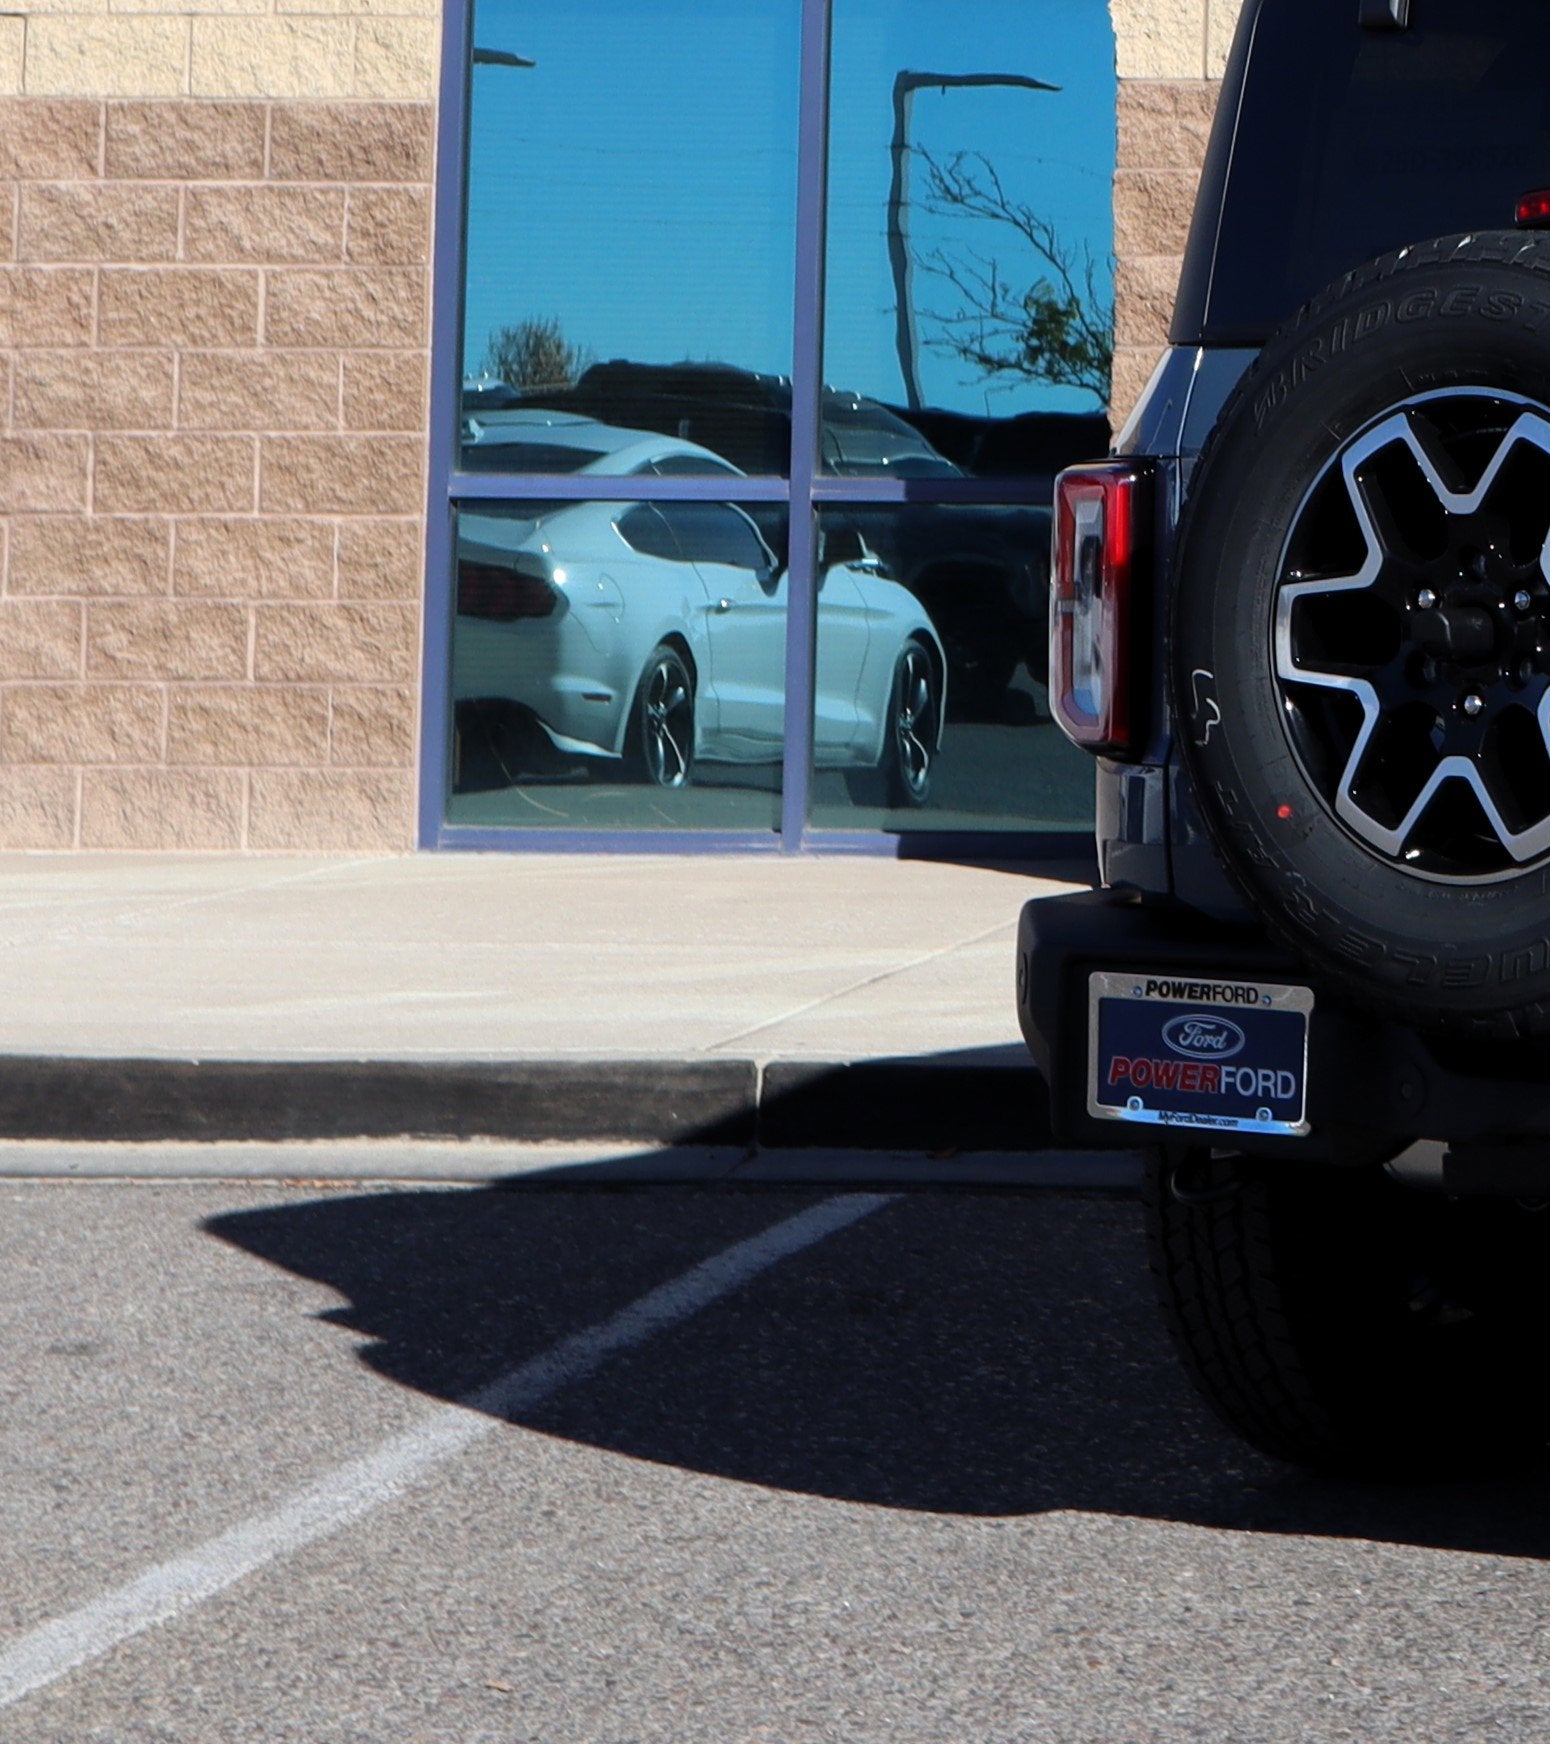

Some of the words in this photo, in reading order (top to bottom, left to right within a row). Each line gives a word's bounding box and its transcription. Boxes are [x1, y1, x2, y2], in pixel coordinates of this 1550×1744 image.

[1145, 979, 1259, 1005] POWERFORD
[1178, 1020, 1227, 1049] Ford
[1107, 1056, 1296, 1099] POWERFORD
